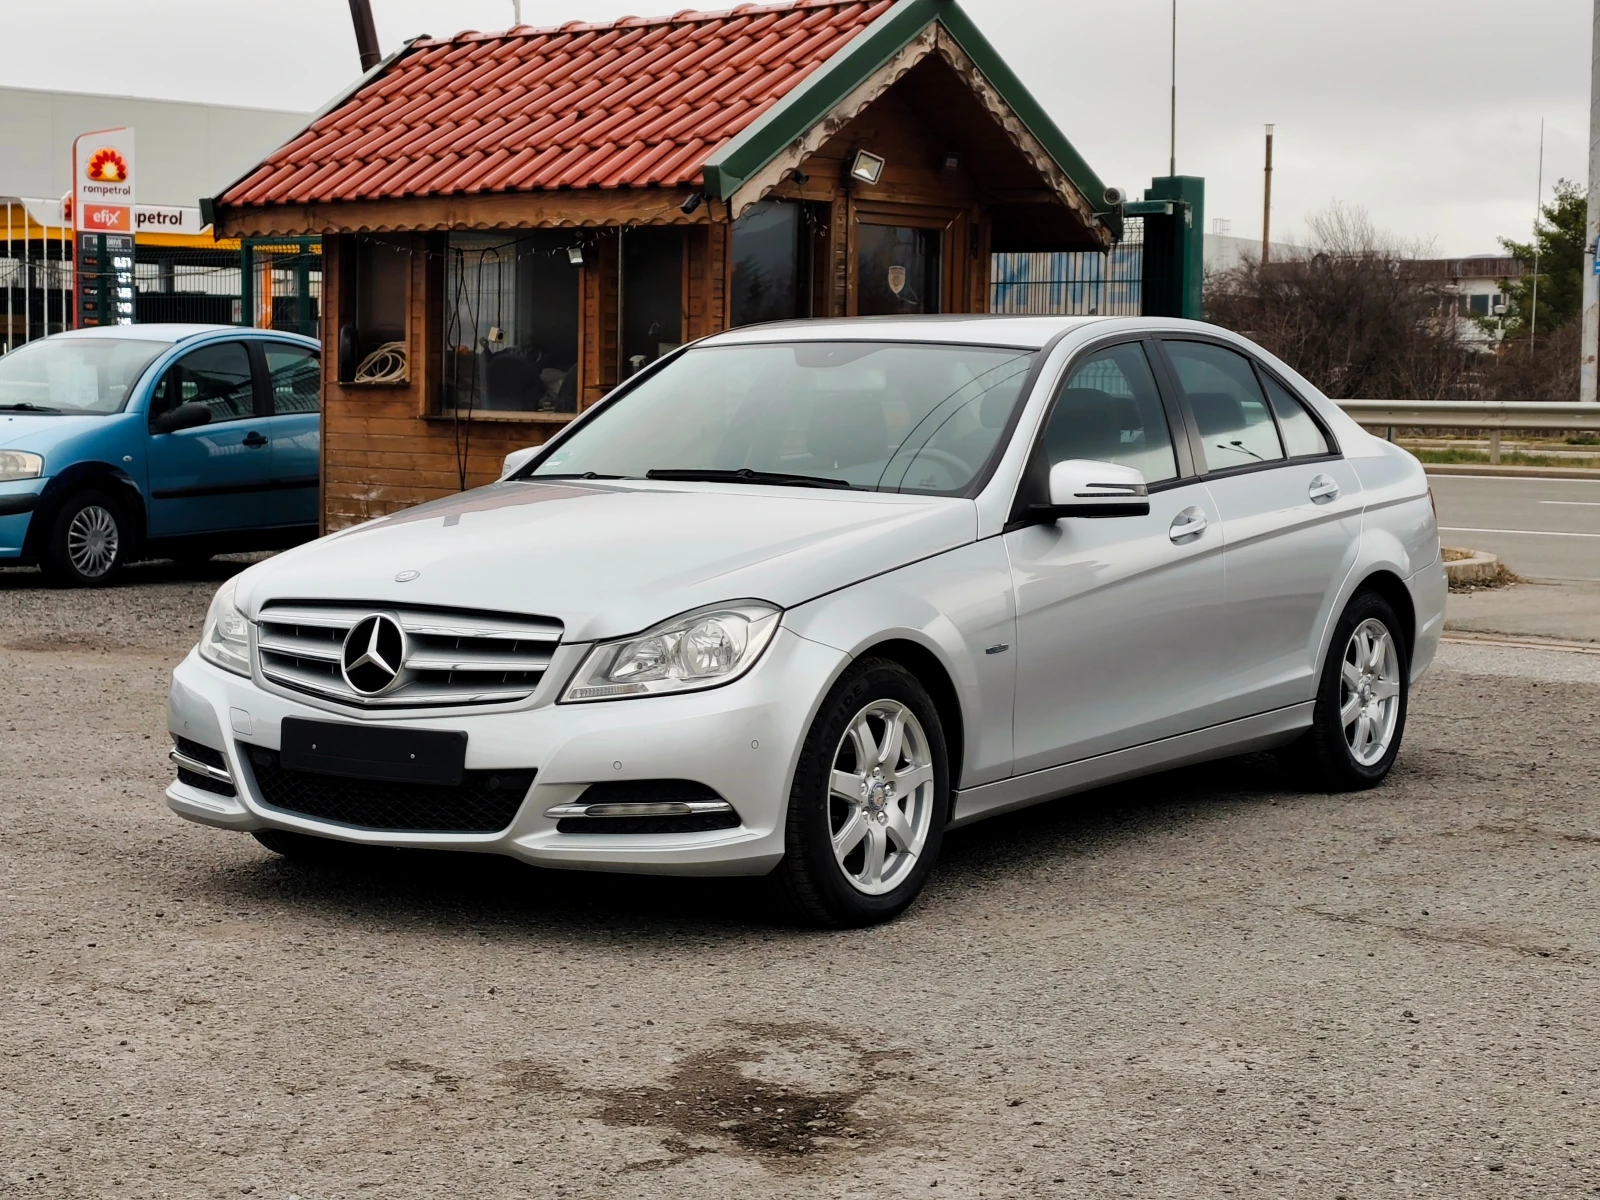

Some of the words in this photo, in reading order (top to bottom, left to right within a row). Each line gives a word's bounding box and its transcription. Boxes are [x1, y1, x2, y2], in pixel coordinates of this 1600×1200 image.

[83, 185, 131, 196] rompetrol
[93, 210, 121, 226] efix
[135, 210, 182, 228] petrol
